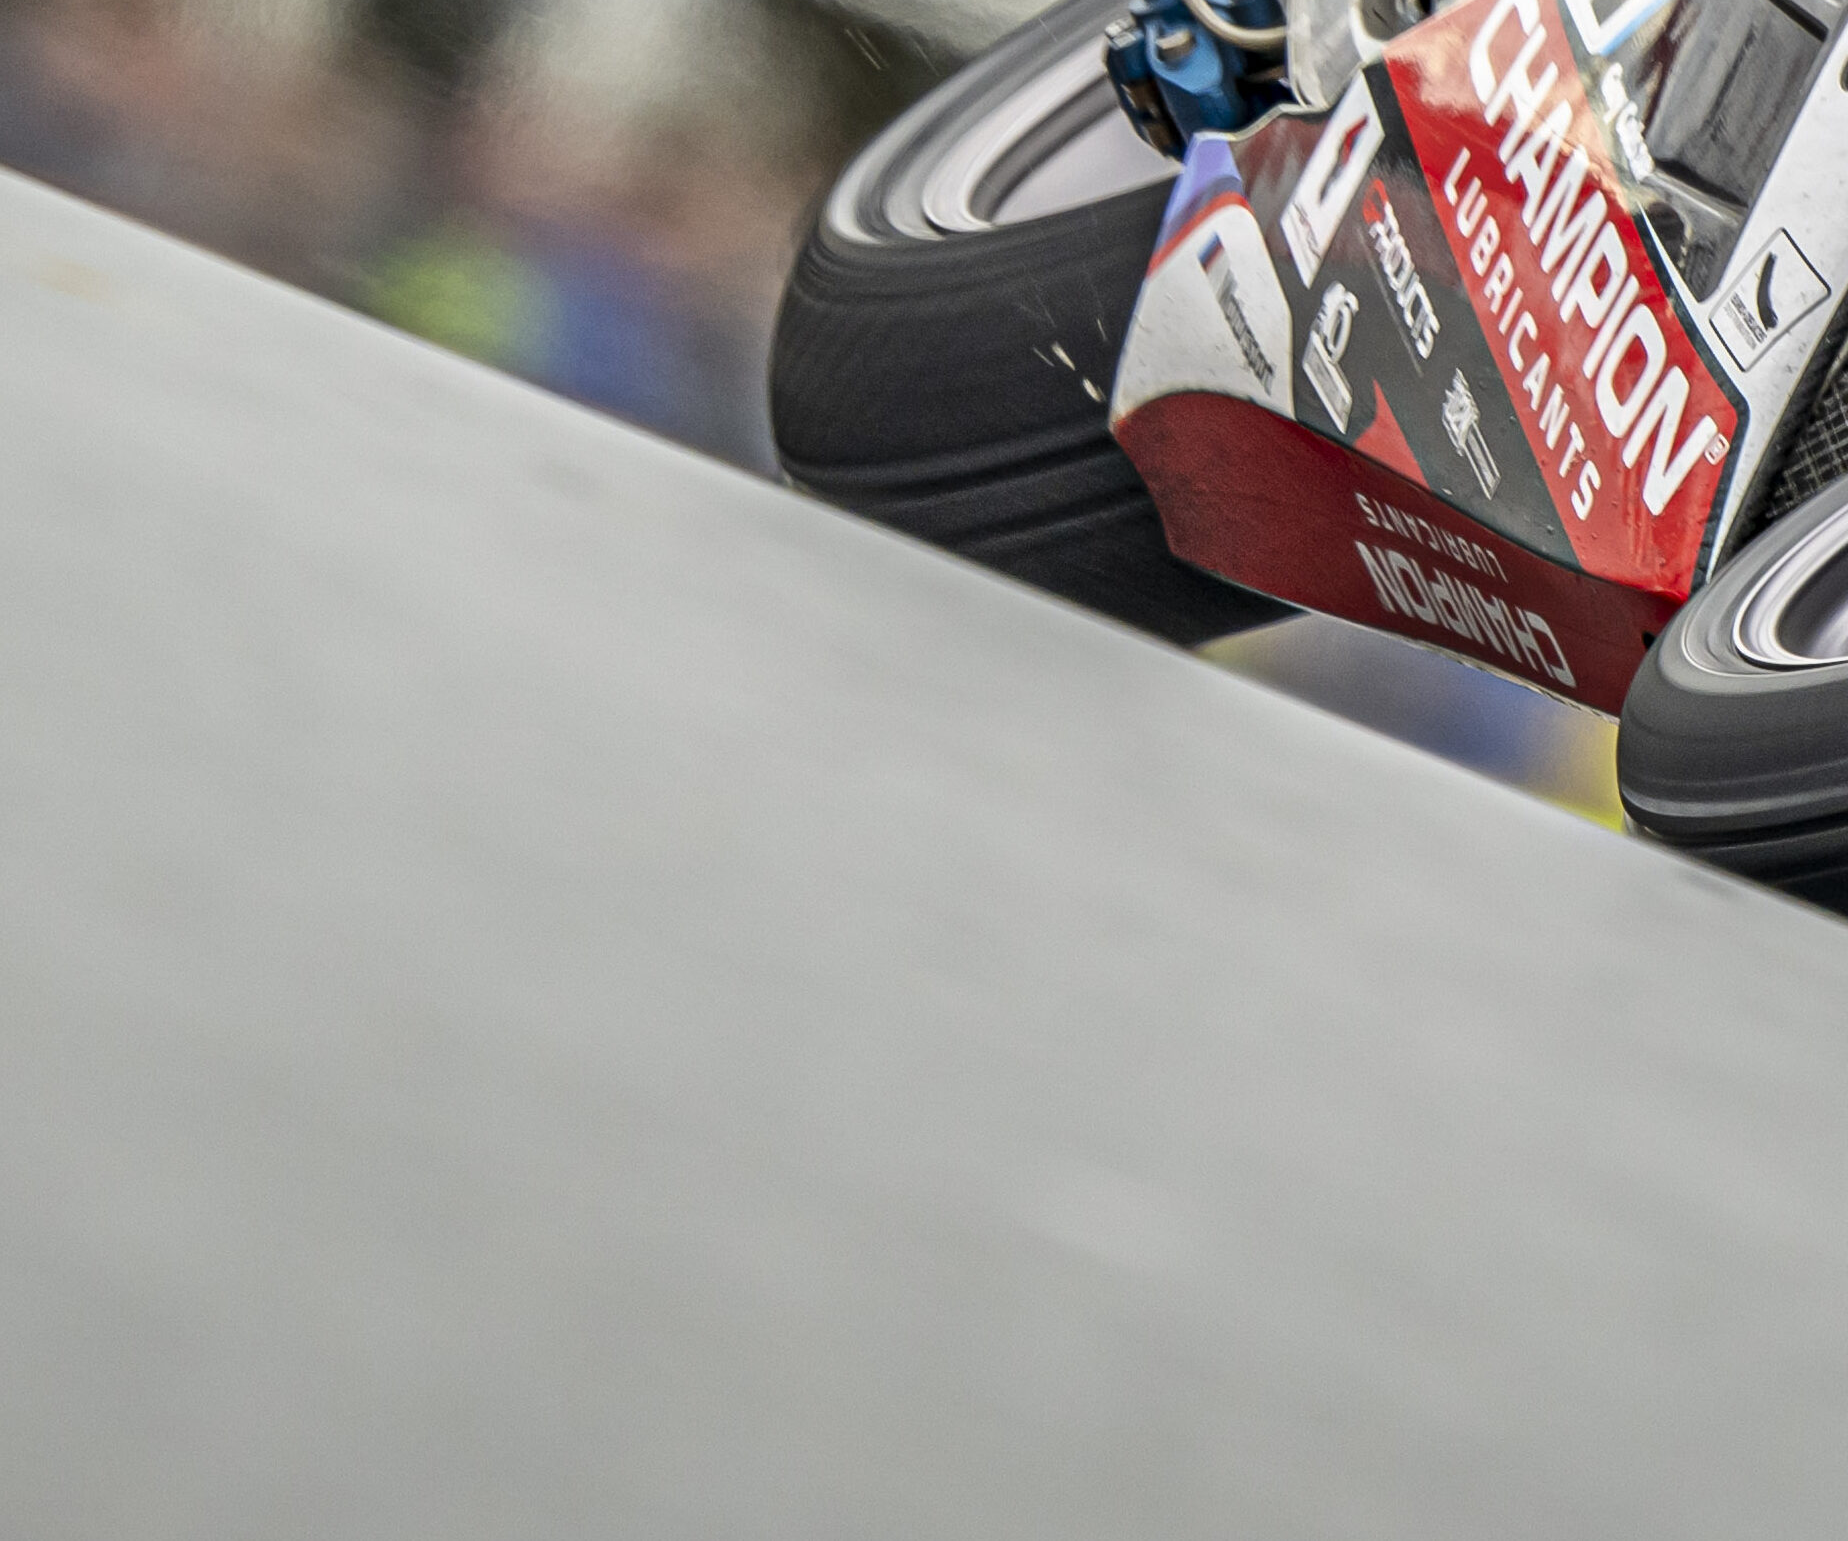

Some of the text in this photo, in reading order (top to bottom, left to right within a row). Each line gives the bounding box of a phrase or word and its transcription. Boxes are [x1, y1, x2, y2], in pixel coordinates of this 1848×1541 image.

[1442, 146, 1602, 521] LUBRICANTS
[1354, 491, 1509, 584] LUBRICANTS
[1354, 540, 1578, 689] CHAMPION
